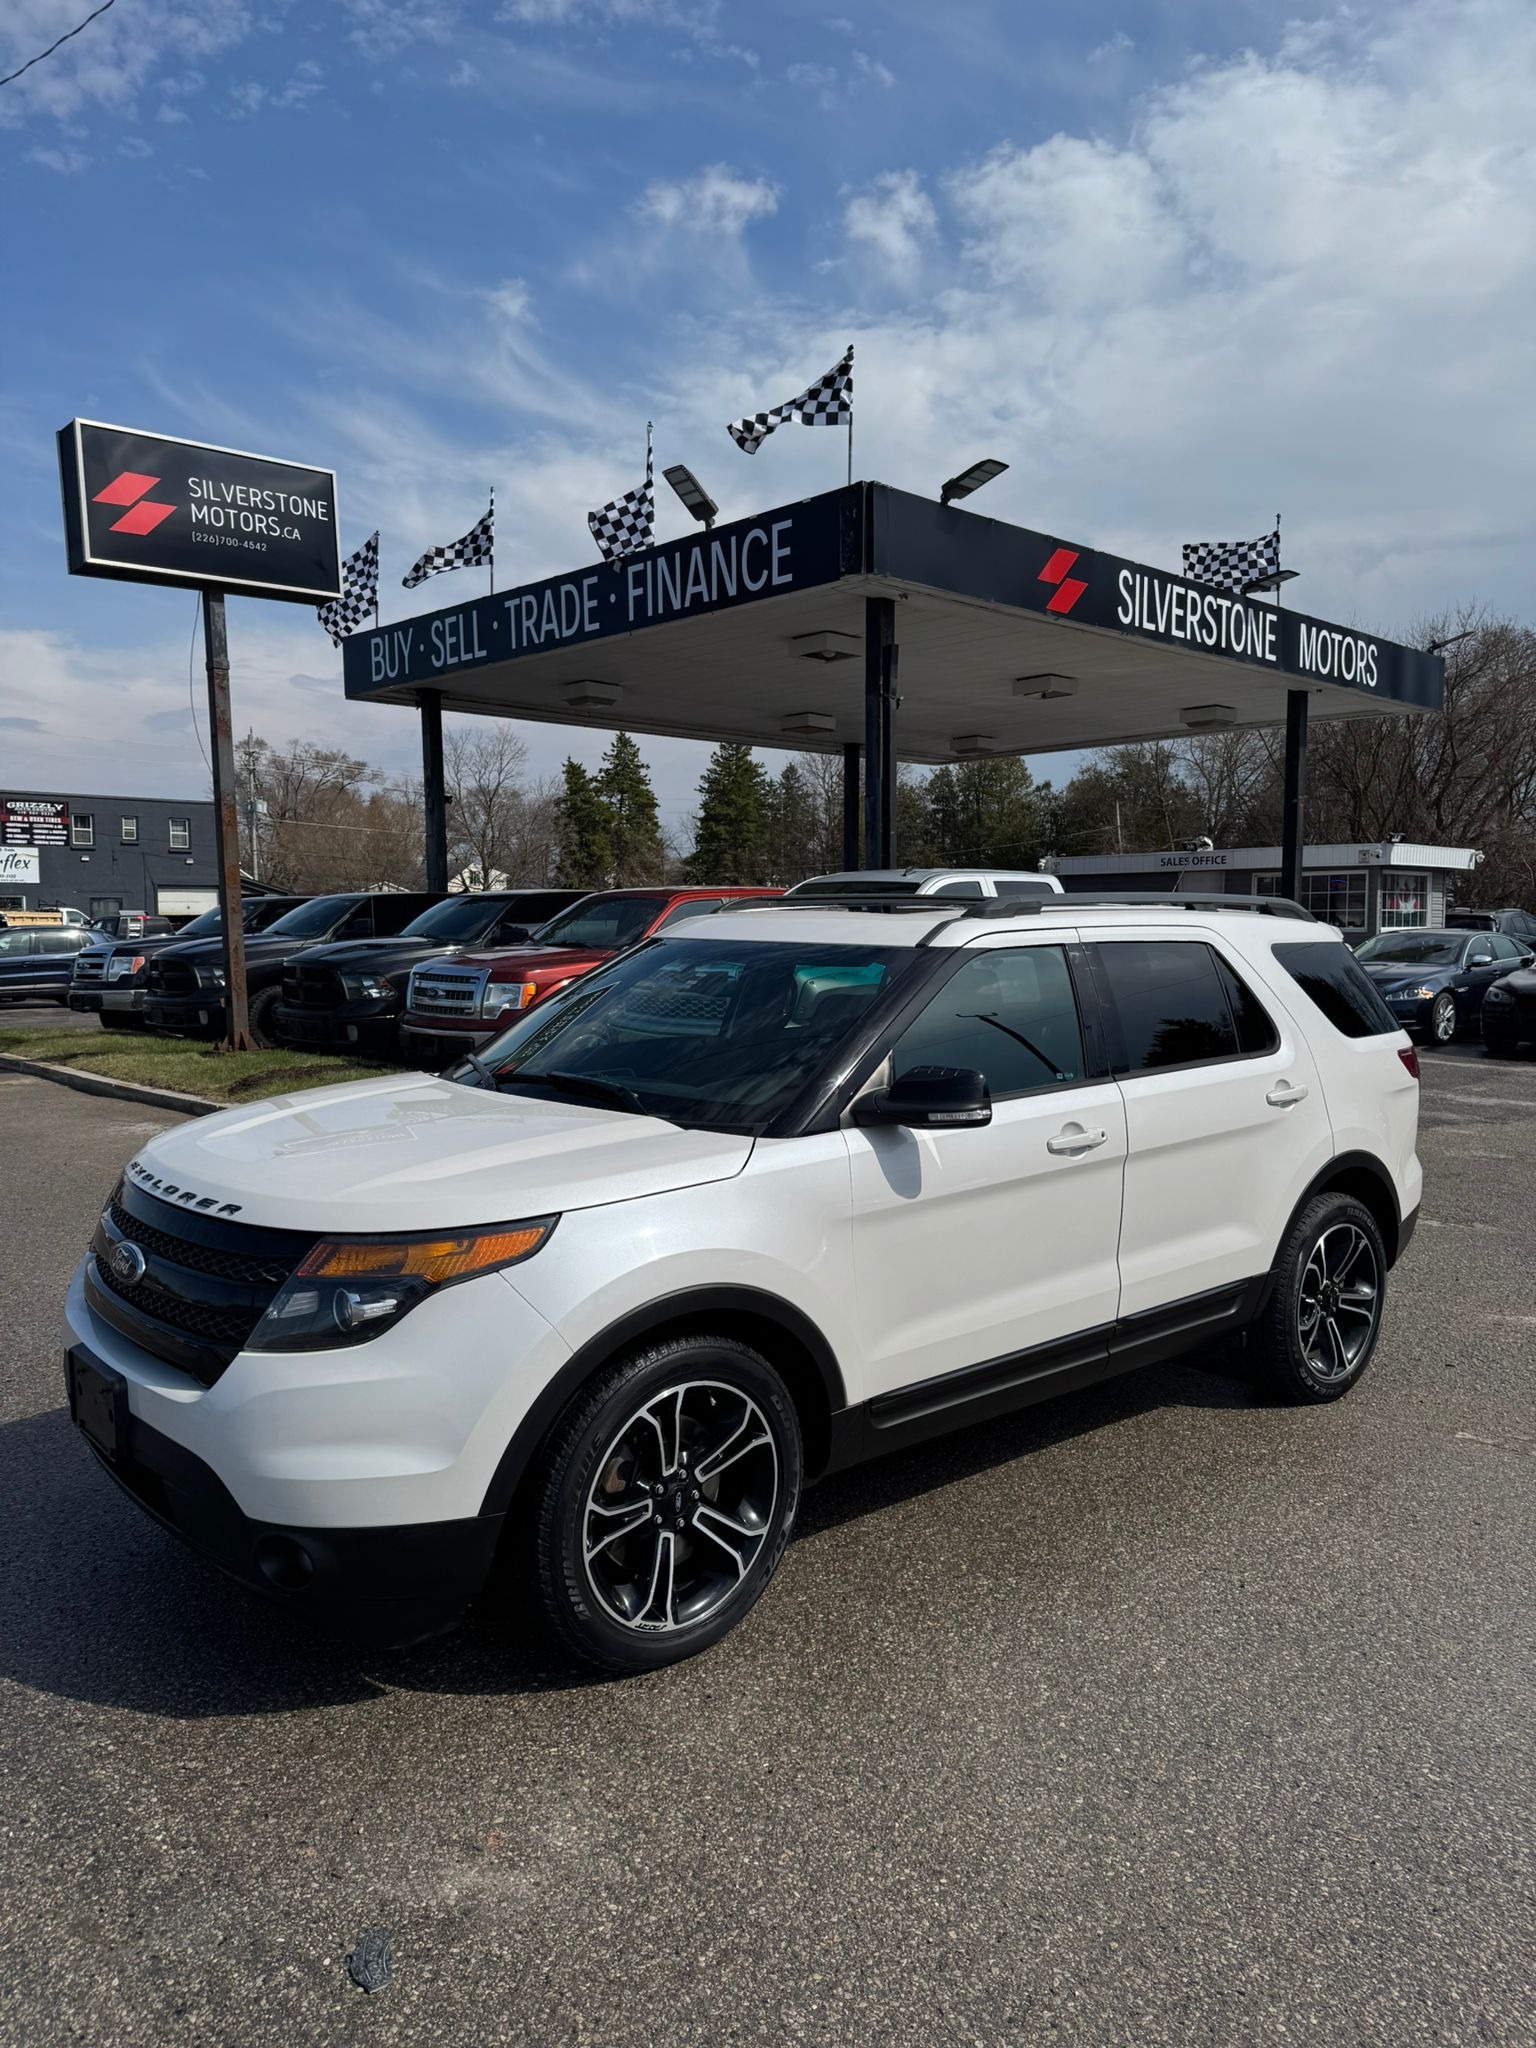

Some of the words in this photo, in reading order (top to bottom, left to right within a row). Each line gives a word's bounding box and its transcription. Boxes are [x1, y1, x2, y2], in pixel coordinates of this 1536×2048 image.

[188, 477, 329, 521] SILVERSTONE
[191, 503, 301, 541] MOTORS.CA
[191, 532, 268, 552] (226)700-4542
[371, 627, 413, 683] BUY
[430, 613, 488, 669] SELL
[504, 575, 600, 650] TRADE
[626, 518, 794, 621] FINANCE
[1117, 569, 1278, 662] SILVERSTONE
[1299, 623, 1378, 687] MOTORS
[6, 801, 64, 811] GRIZZLY
[1160, 856, 1190, 867] SALES
[1192, 855, 1227, 866] OFFICE
[130, 1160, 243, 1216] EXPLORER
[111, 1247, 133, 1275] Ford
